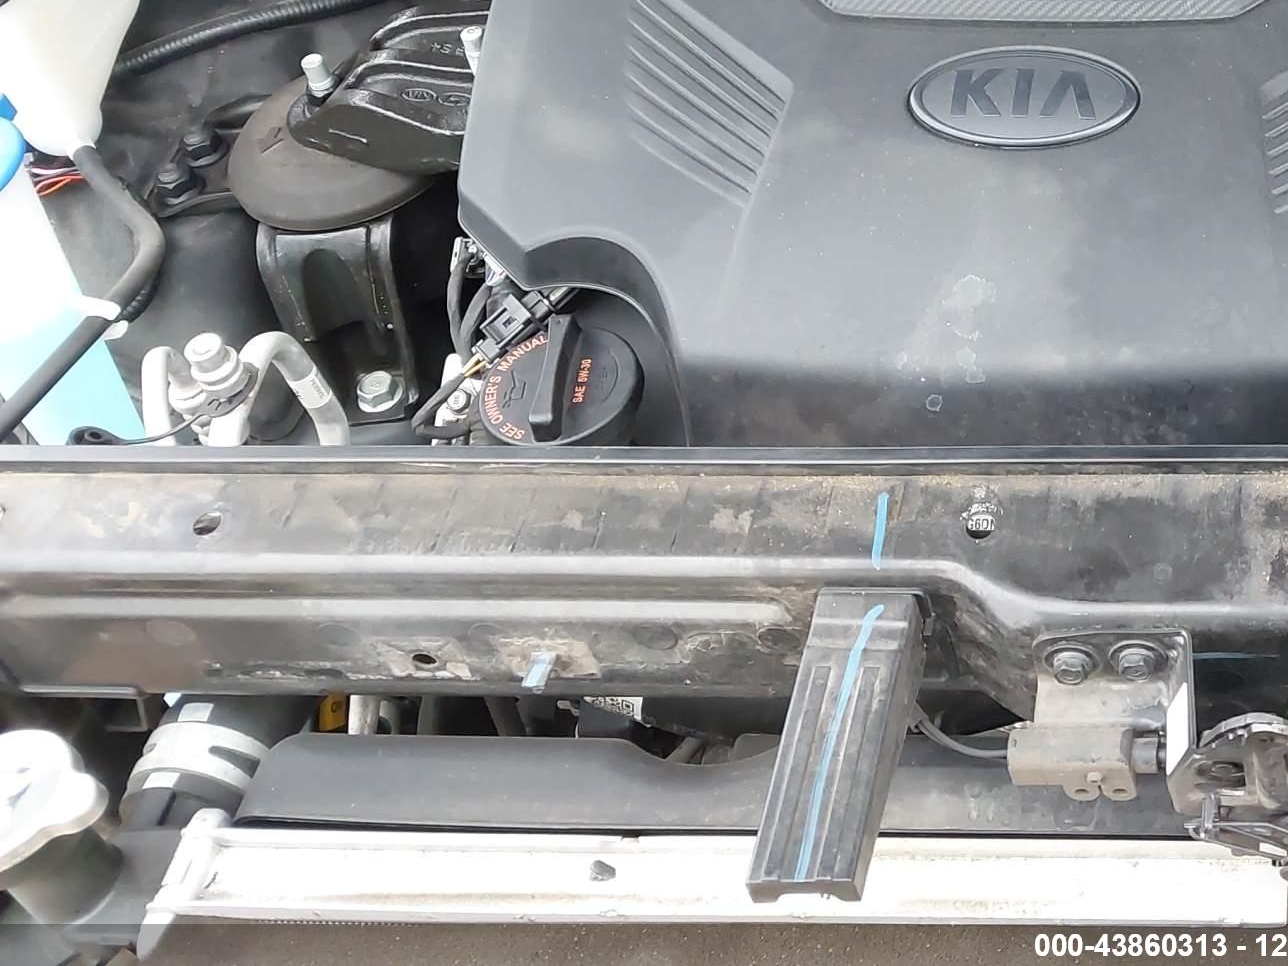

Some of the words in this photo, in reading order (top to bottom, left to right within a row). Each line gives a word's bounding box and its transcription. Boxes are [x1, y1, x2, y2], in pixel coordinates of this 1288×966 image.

[951, 67, 1097, 120] KIA
[497, 333, 549, 372] MANUAL
[577, 358, 592, 383] 5W-30
[484, 375, 503, 425] OWNER'S
[572, 385, 586, 404] SAE
[499, 422, 525, 440] SEE
